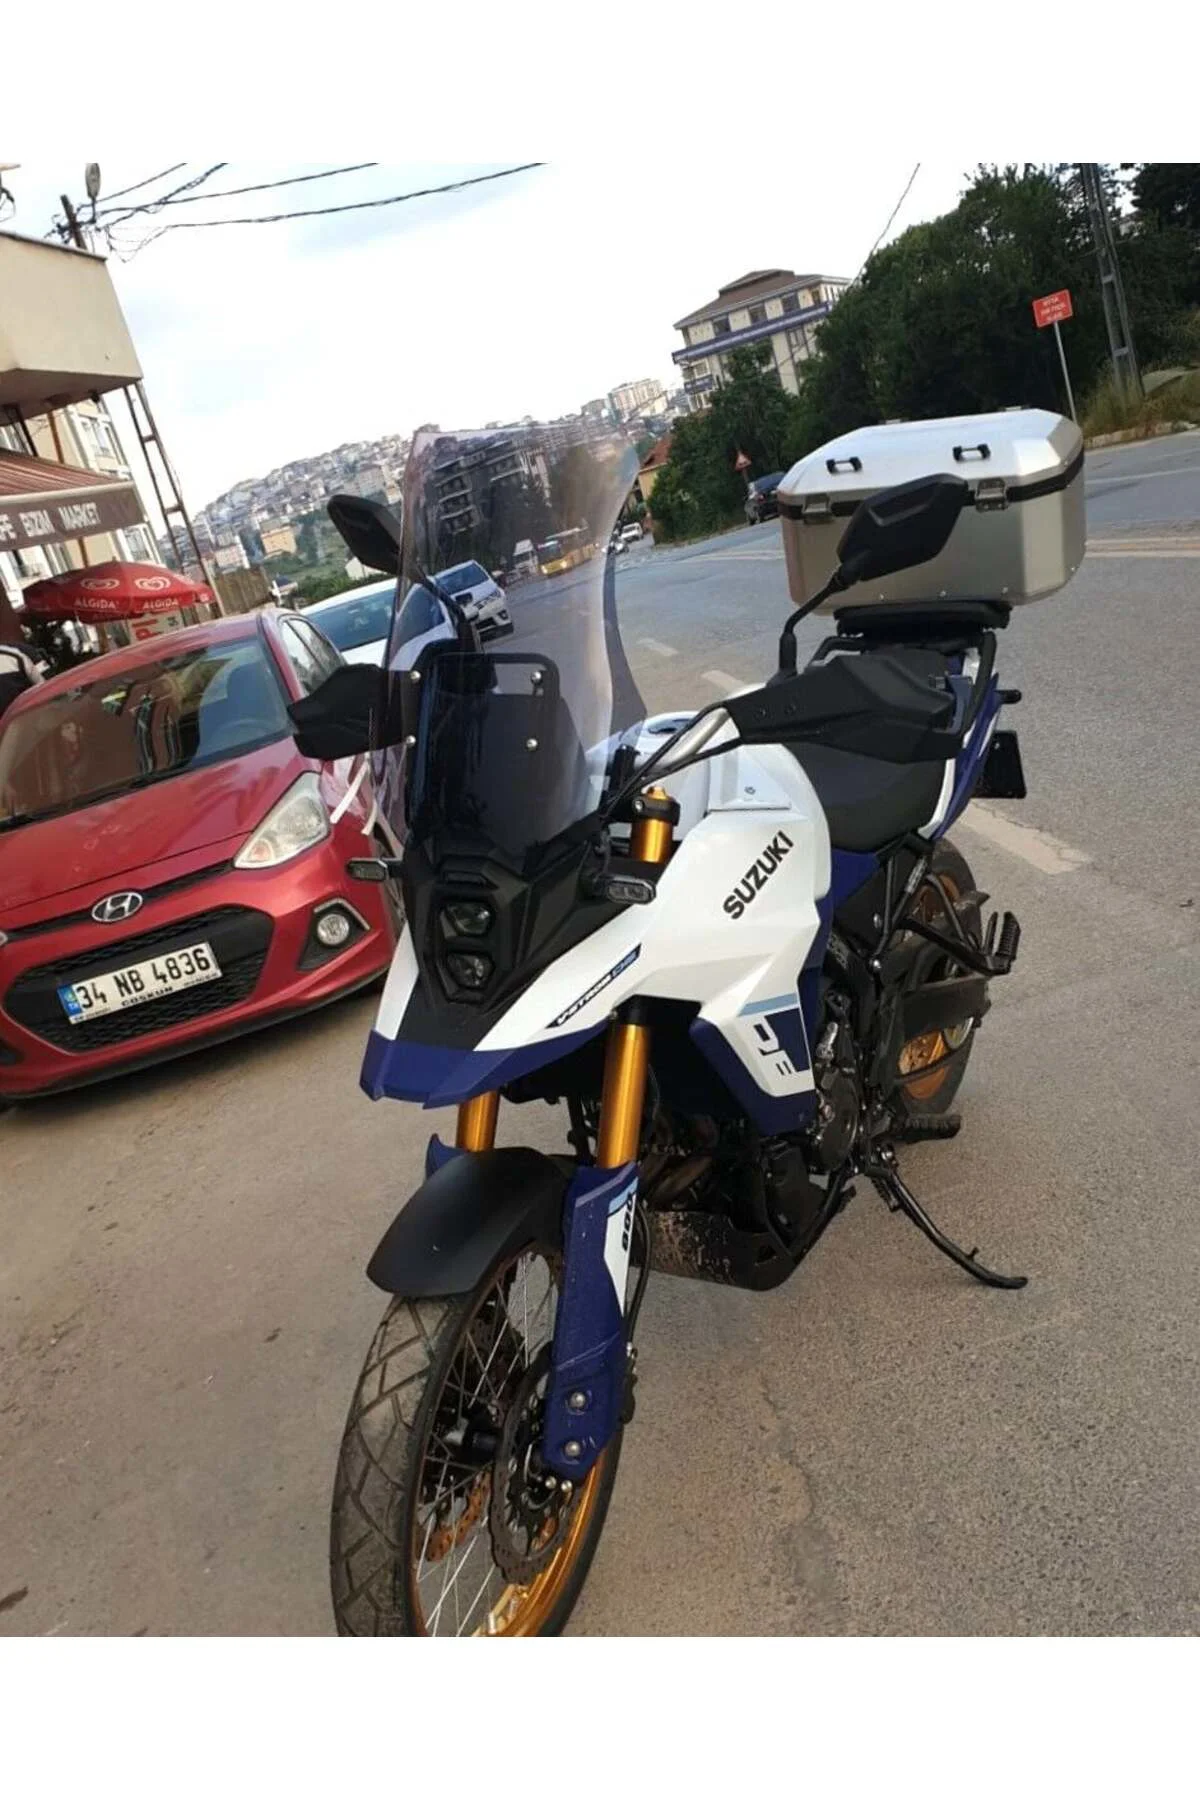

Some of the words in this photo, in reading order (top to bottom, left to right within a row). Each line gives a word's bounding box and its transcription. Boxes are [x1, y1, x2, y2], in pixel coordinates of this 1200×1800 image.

[58, 502, 101, 530] MARKET
[74, 598, 116, 609] ALGIDA
[142, 598, 179, 609] ALGIDA
[723, 830, 794, 919] SUZUKI
[77, 983, 107, 1009] 34
[113, 969, 145, 997] NB
[151, 948, 211, 984] 4836
